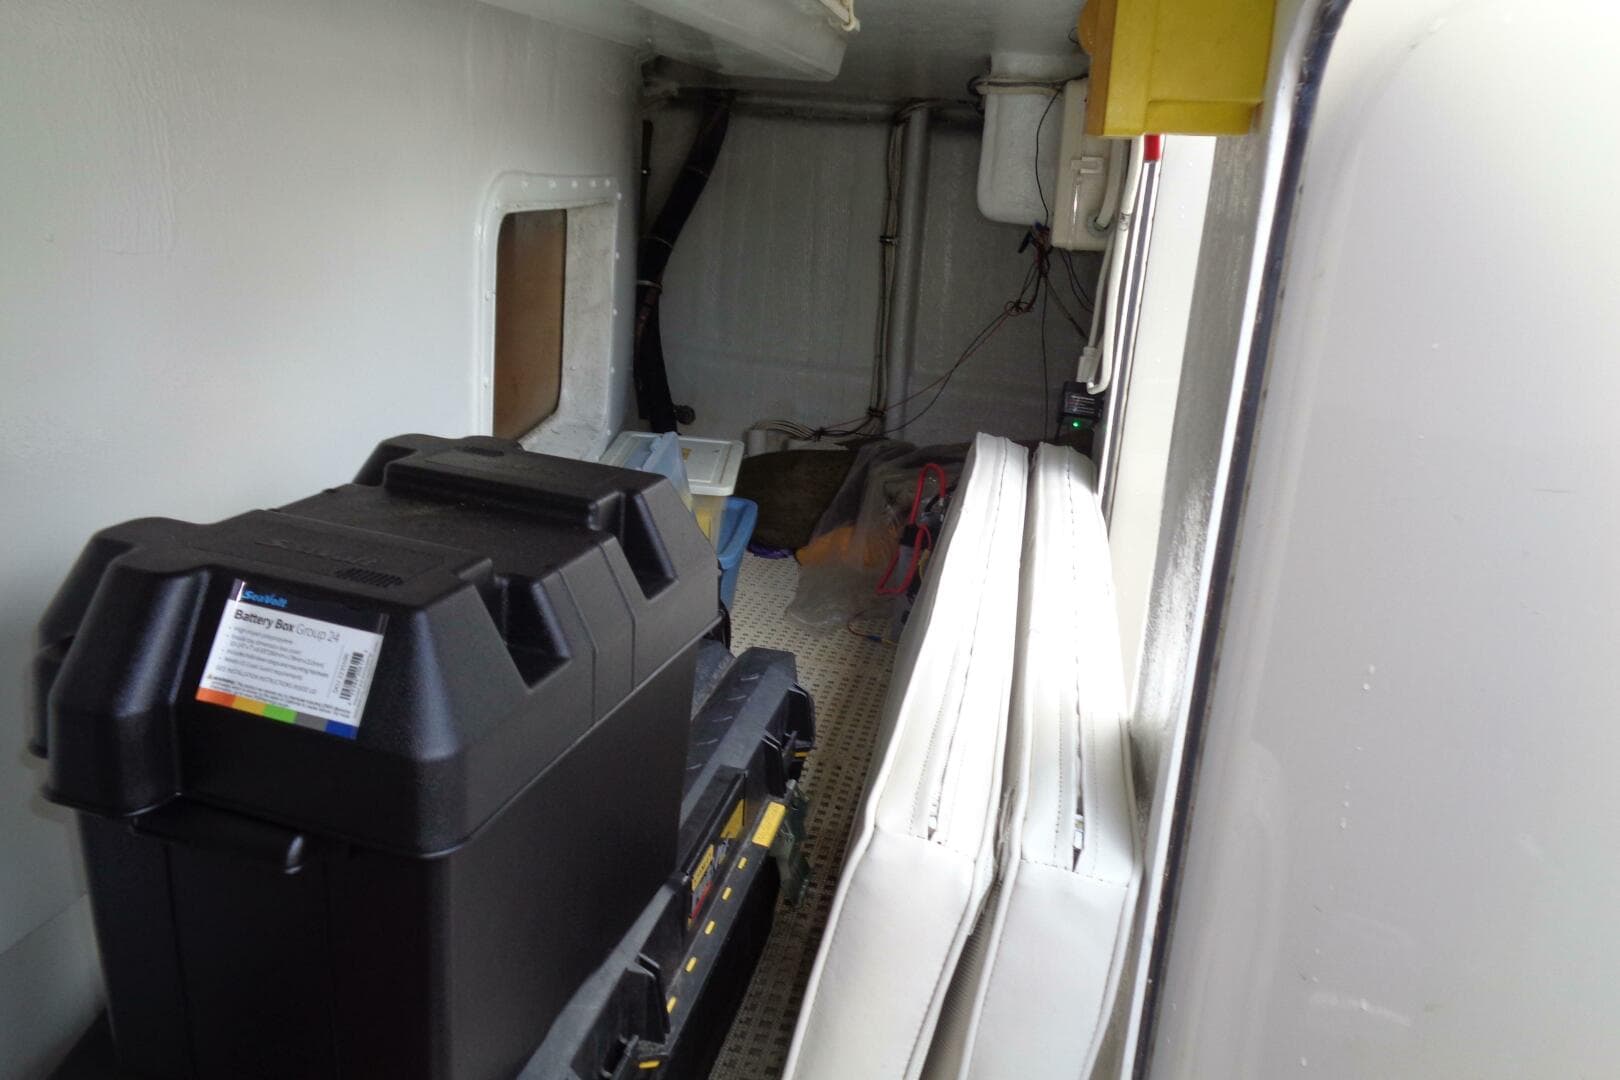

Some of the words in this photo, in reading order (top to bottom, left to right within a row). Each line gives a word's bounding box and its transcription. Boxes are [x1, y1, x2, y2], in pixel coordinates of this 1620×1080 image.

[234, 609, 274, 629] Battery
[275, 618, 295, 632] Box
[296, 624, 328, 641] Group
[328, 631, 342, 643] 24
